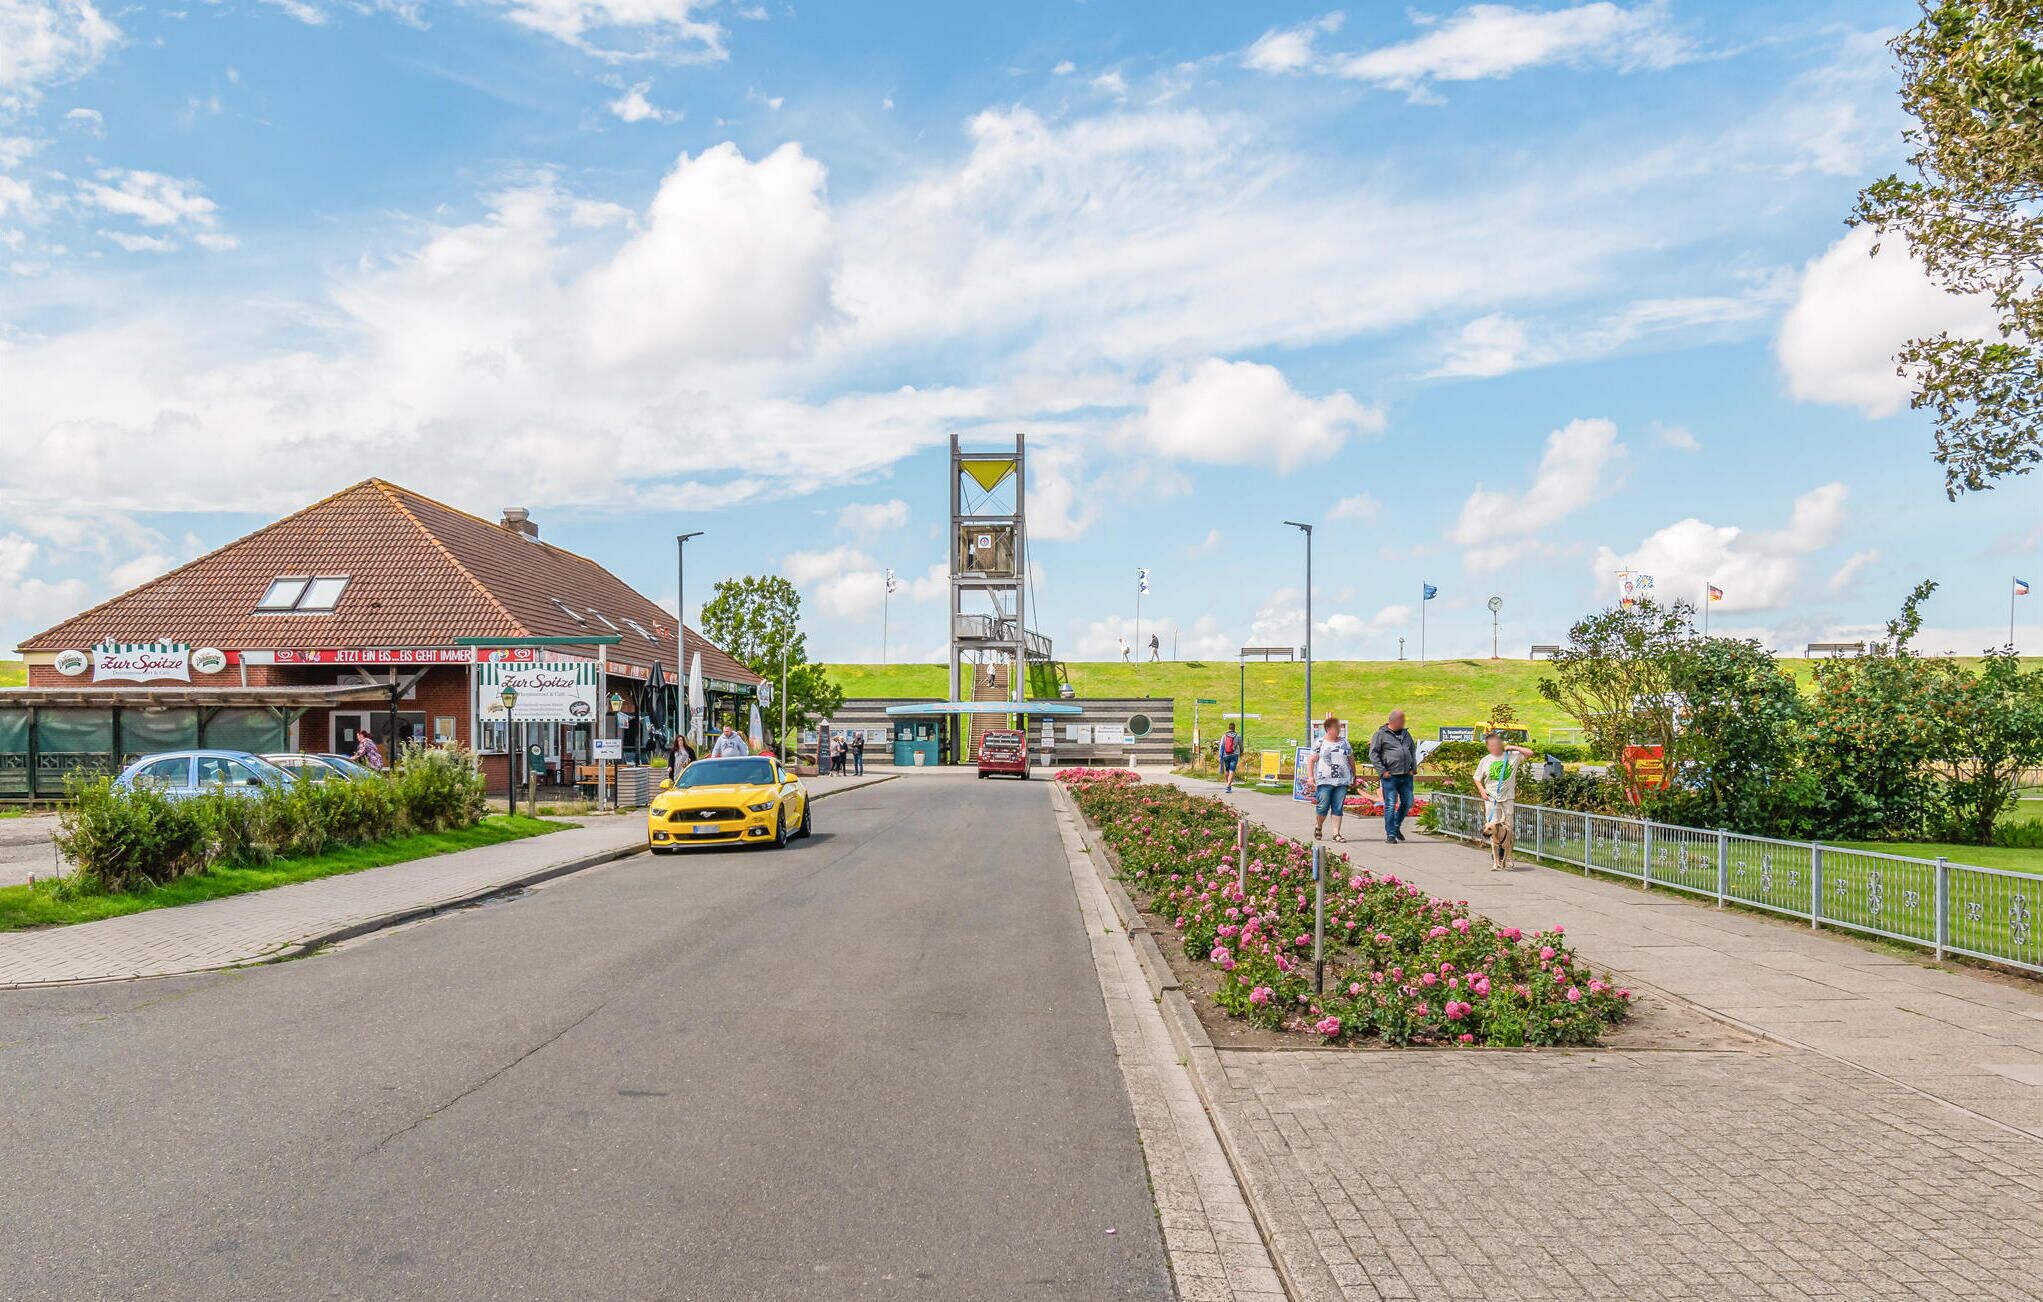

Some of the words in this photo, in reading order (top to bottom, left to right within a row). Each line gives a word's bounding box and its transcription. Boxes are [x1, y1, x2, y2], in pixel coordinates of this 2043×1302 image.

[101, 656, 131, 670] Zur
[132, 654, 183, 673] Spitze
[334, 650, 360, 662] JETZT
[362, 650, 376, 662] EIN
[415, 650, 438, 662] GEHT
[440, 650, 472, 662] IMMER
[501, 674, 528, 688] Zur
[529, 673, 575, 692] Spitze
